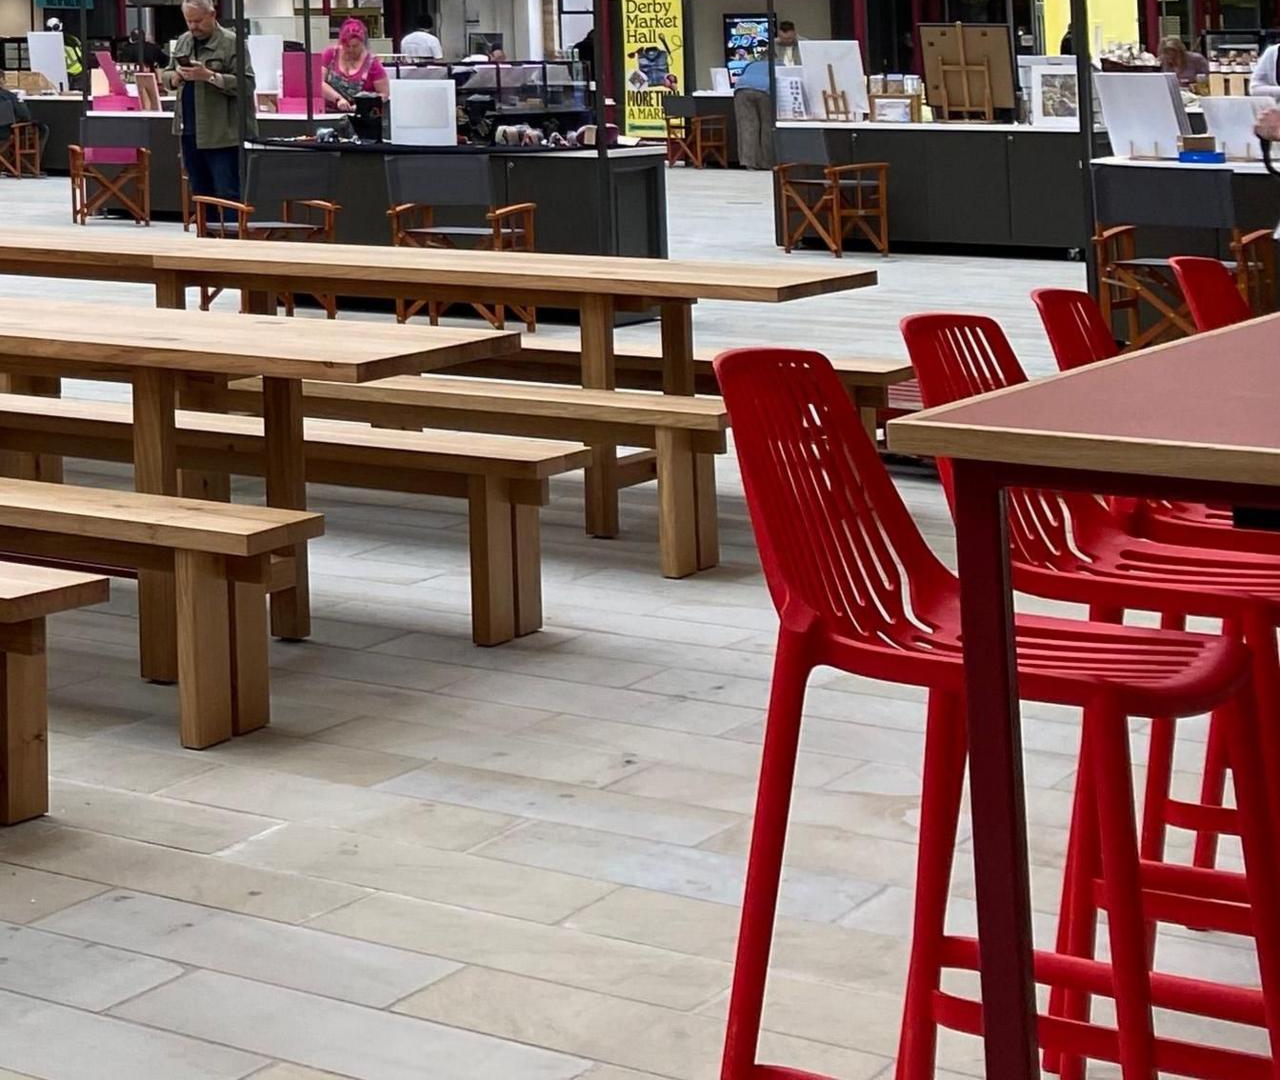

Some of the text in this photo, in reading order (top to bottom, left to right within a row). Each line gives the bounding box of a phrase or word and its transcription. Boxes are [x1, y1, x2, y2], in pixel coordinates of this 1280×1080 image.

[625, 0, 672, 17] Derby
[626, 14, 678, 29] Market
[627, 29, 657, 44] Hall
[627, 90, 654, 107] MORE
[628, 107, 636, 120] A
